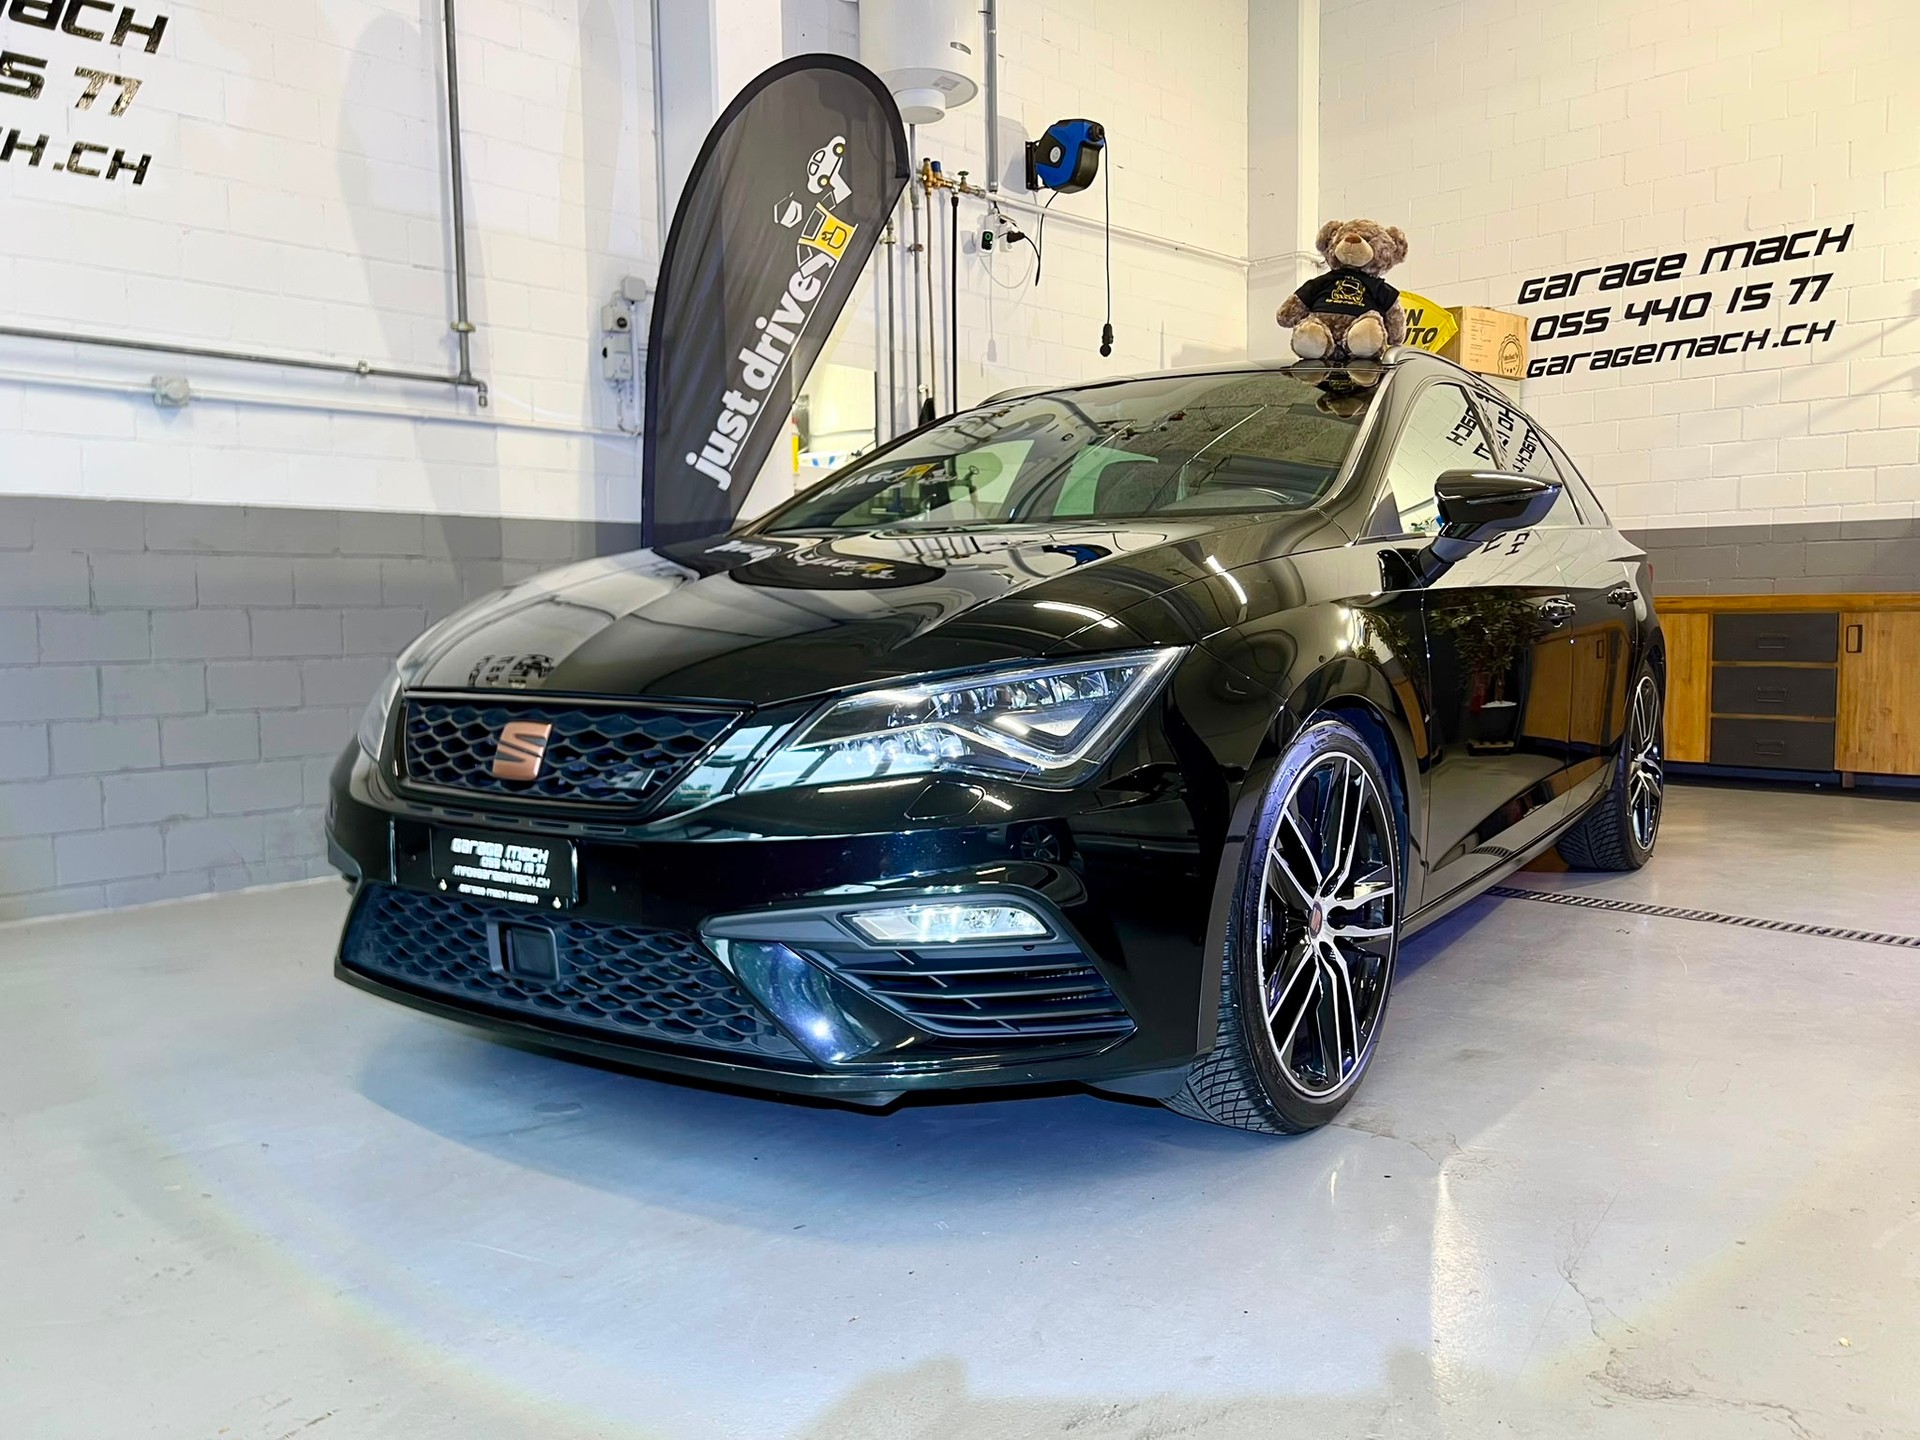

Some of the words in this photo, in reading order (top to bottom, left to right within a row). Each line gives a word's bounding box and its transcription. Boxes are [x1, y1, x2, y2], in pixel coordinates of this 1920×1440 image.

[74, 66, 143, 118] 77
[1404, 308, 1424, 326] N
[1530, 307, 1612, 342] 055
[1624, 291, 1713, 327] 440
[1726, 282, 1774, 314] 15
[1788, 273, 1835, 306] 77
[684, 390, 760, 492] just
